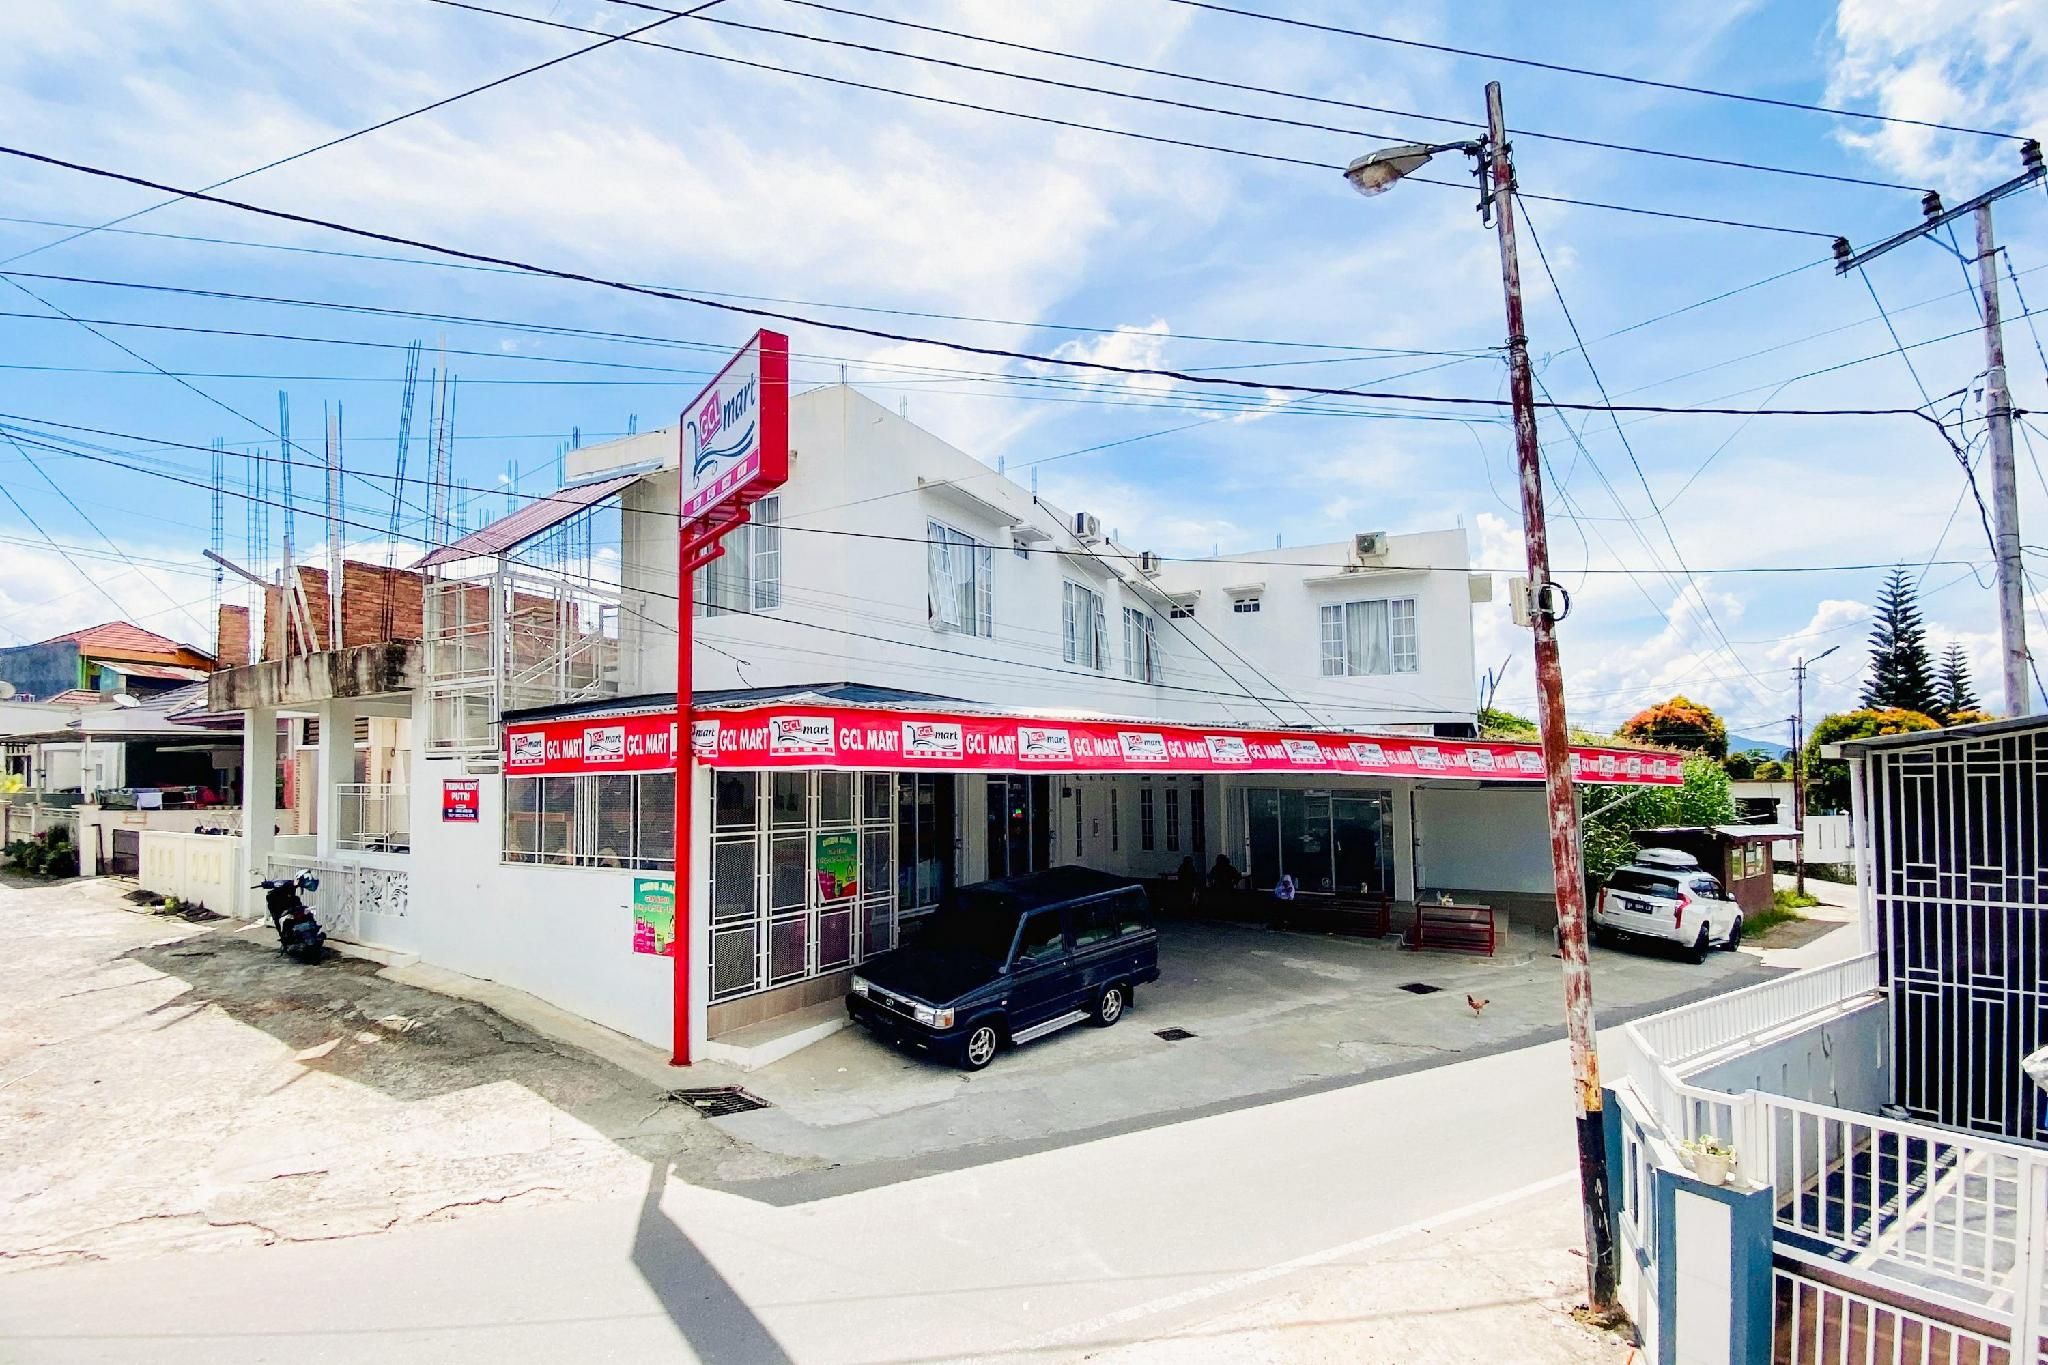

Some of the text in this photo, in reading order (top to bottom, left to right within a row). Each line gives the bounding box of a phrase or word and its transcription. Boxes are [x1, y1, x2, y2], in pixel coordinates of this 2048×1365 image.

[701, 373, 755, 440] GCL mart
[782, 720, 829, 734] GCL mart
[918, 726, 958, 740] GCL mart
[528, 739, 542, 748] mart
[547, 738, 582, 759] GCL MART
[605, 734, 621, 744] mart
[627, 733, 668, 756] GCL MART
[720, 728, 768, 751] GCL MART
[840, 728, 898, 751] GCL MART
[966, 733, 1016, 755] GCL MART
[1047, 735, 1067, 745] mart
[1073, 738, 1120, 757] GCL MART
[1168, 741, 1209, 758] GCL MART
